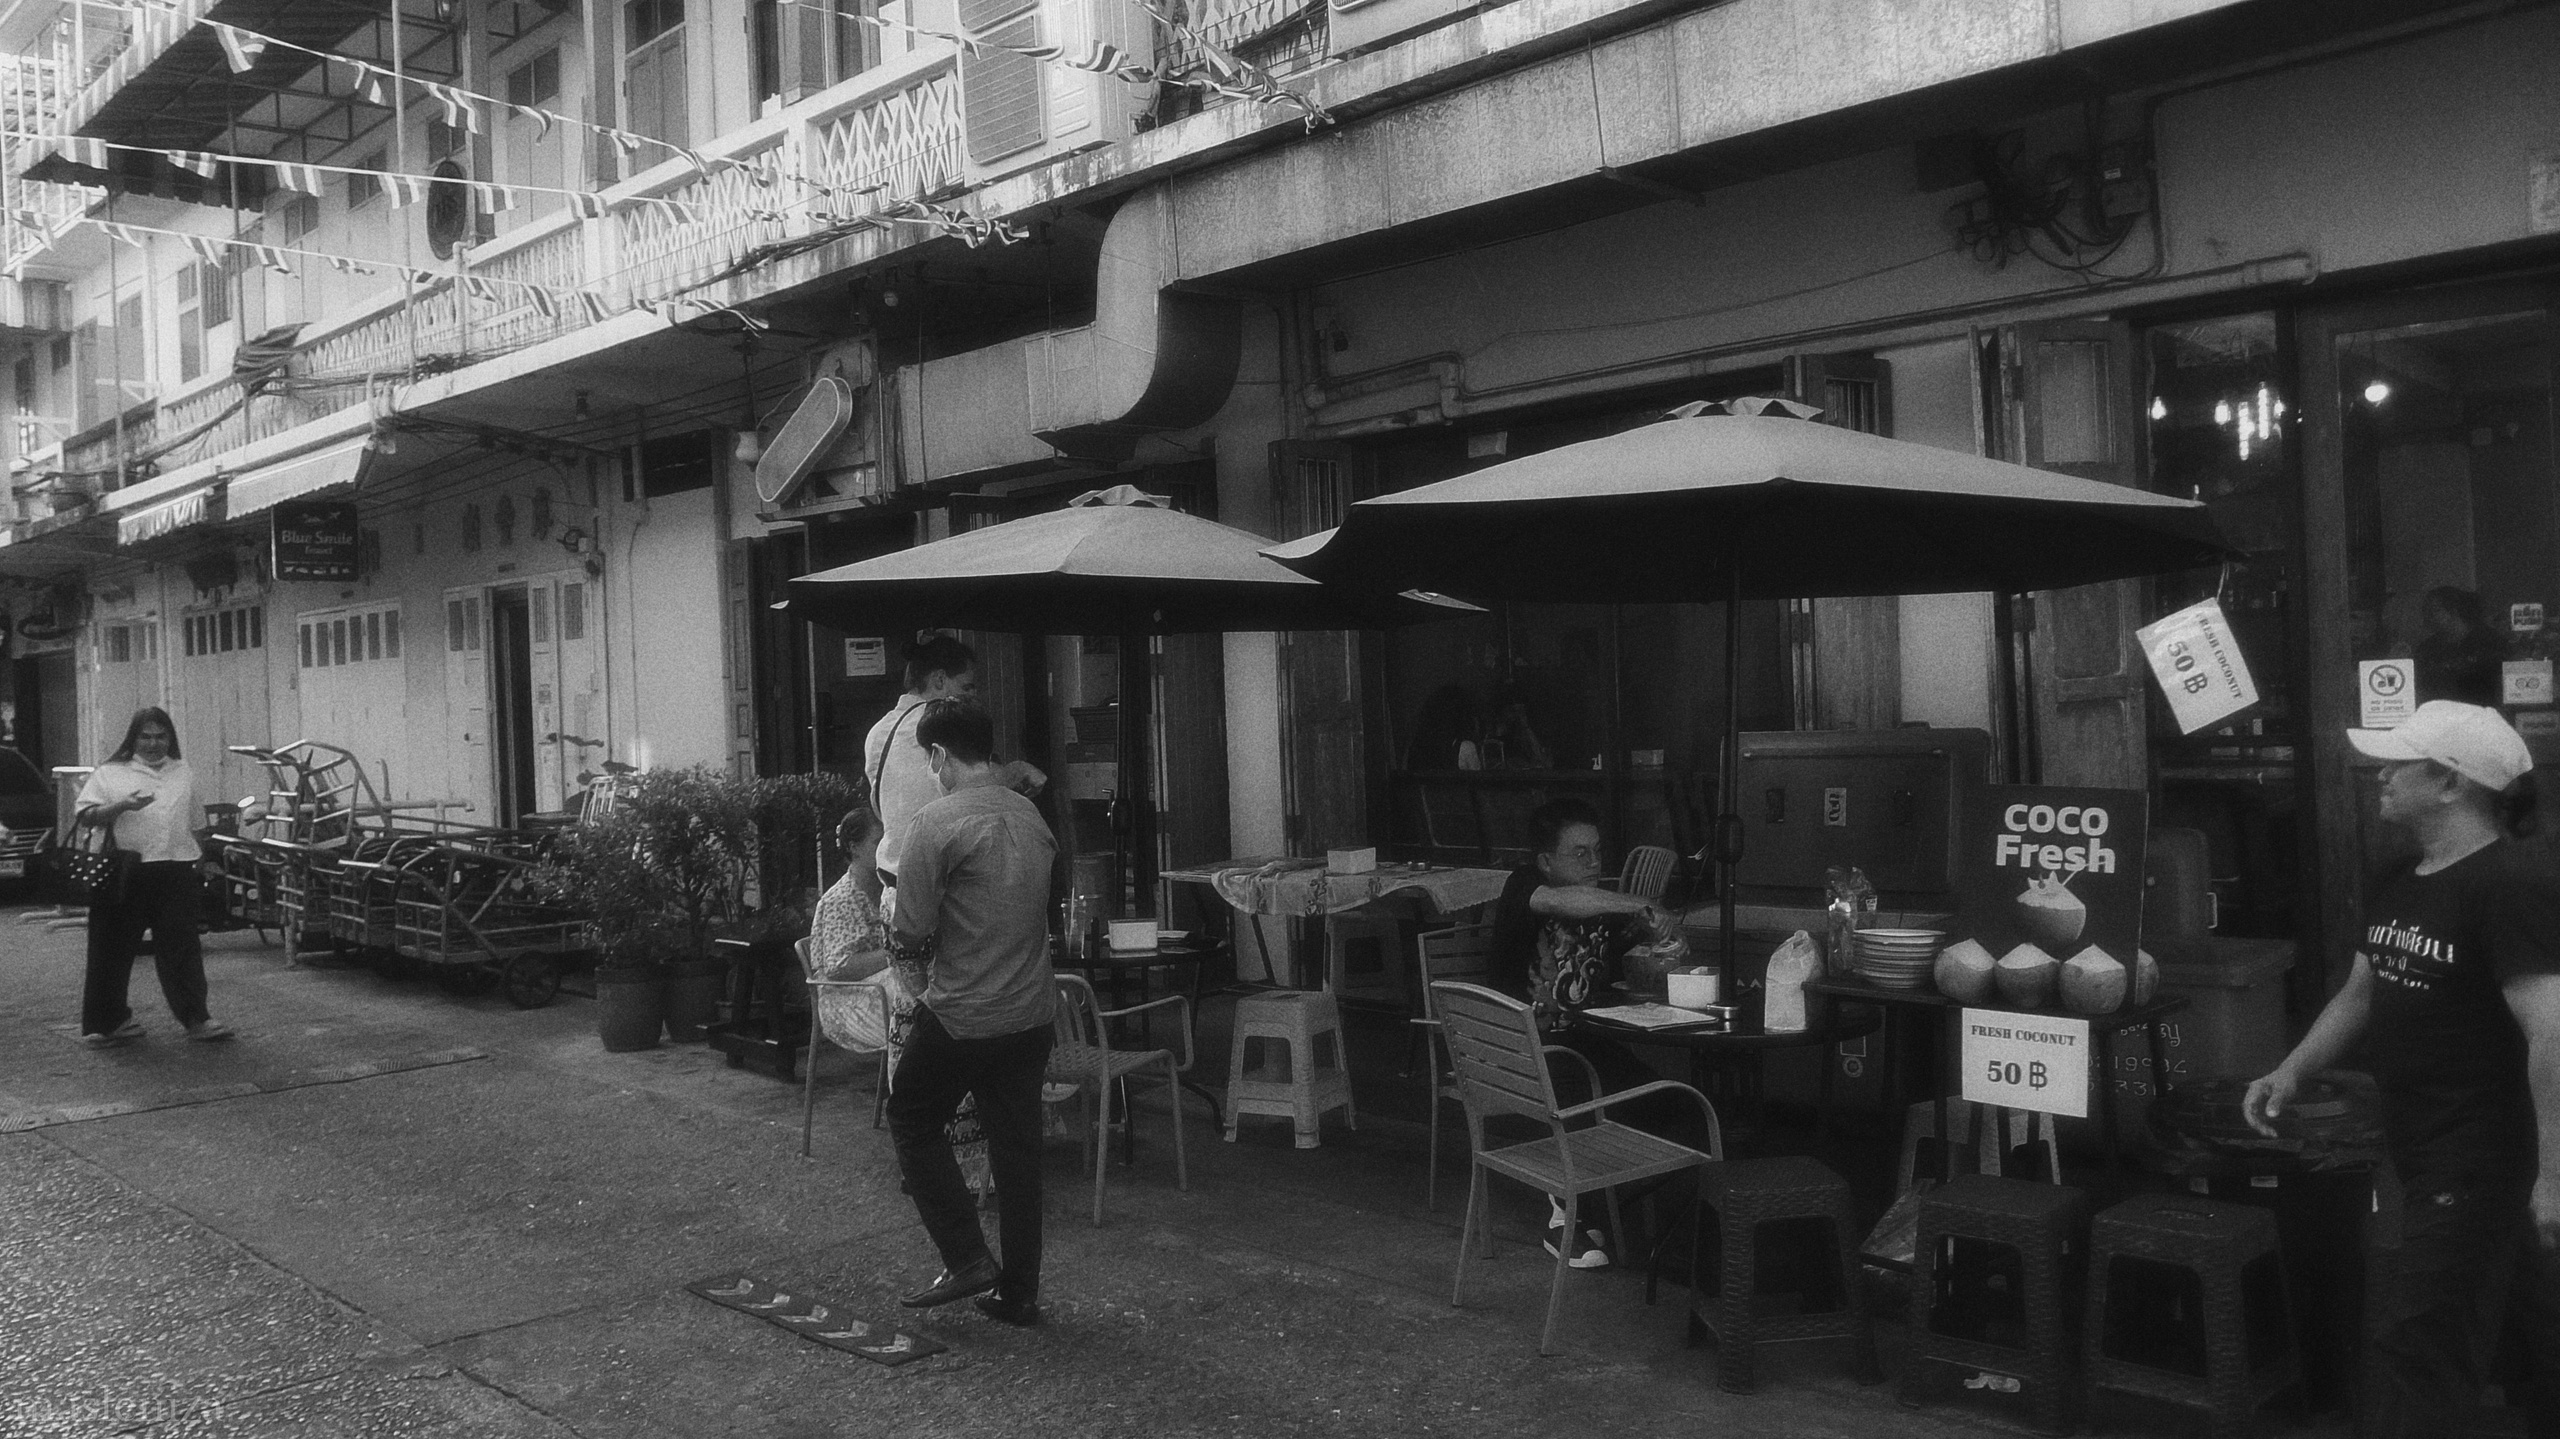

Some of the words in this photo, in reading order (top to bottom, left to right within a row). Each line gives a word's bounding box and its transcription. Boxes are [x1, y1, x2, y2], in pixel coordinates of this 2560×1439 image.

[282, 530, 312, 543] Blue
[316, 531, 353, 544] Smile
[2167, 641, 2195, 672] 50
[2214, 649, 2243, 699] COCONUT
[1996, 834, 2116, 874] Fresh
[1971, 1025, 2012, 1039] FRESH
[2015, 1029, 2076, 1046] COCONUT
[1987, 1060, 2022, 1085] 50
